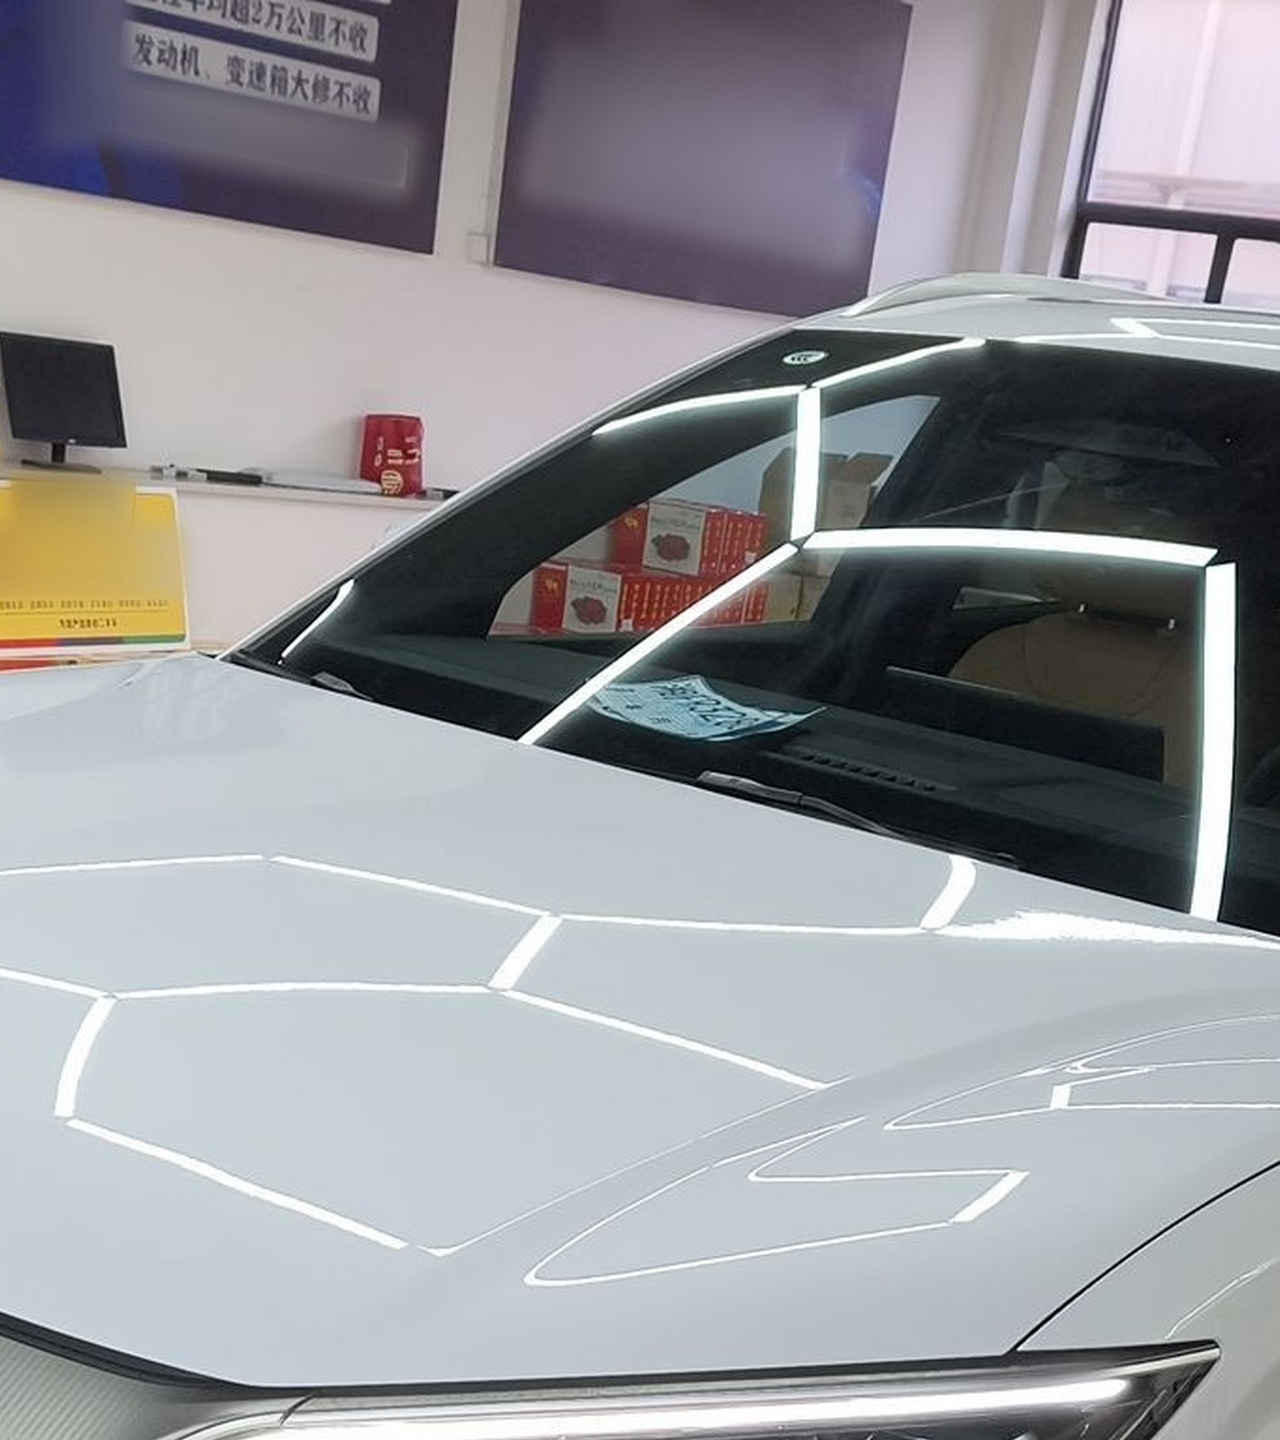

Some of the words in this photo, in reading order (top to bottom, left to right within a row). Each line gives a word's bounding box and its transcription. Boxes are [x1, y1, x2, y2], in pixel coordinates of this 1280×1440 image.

[133, 33, 372, 116] 发动机、变速箱大修不收
